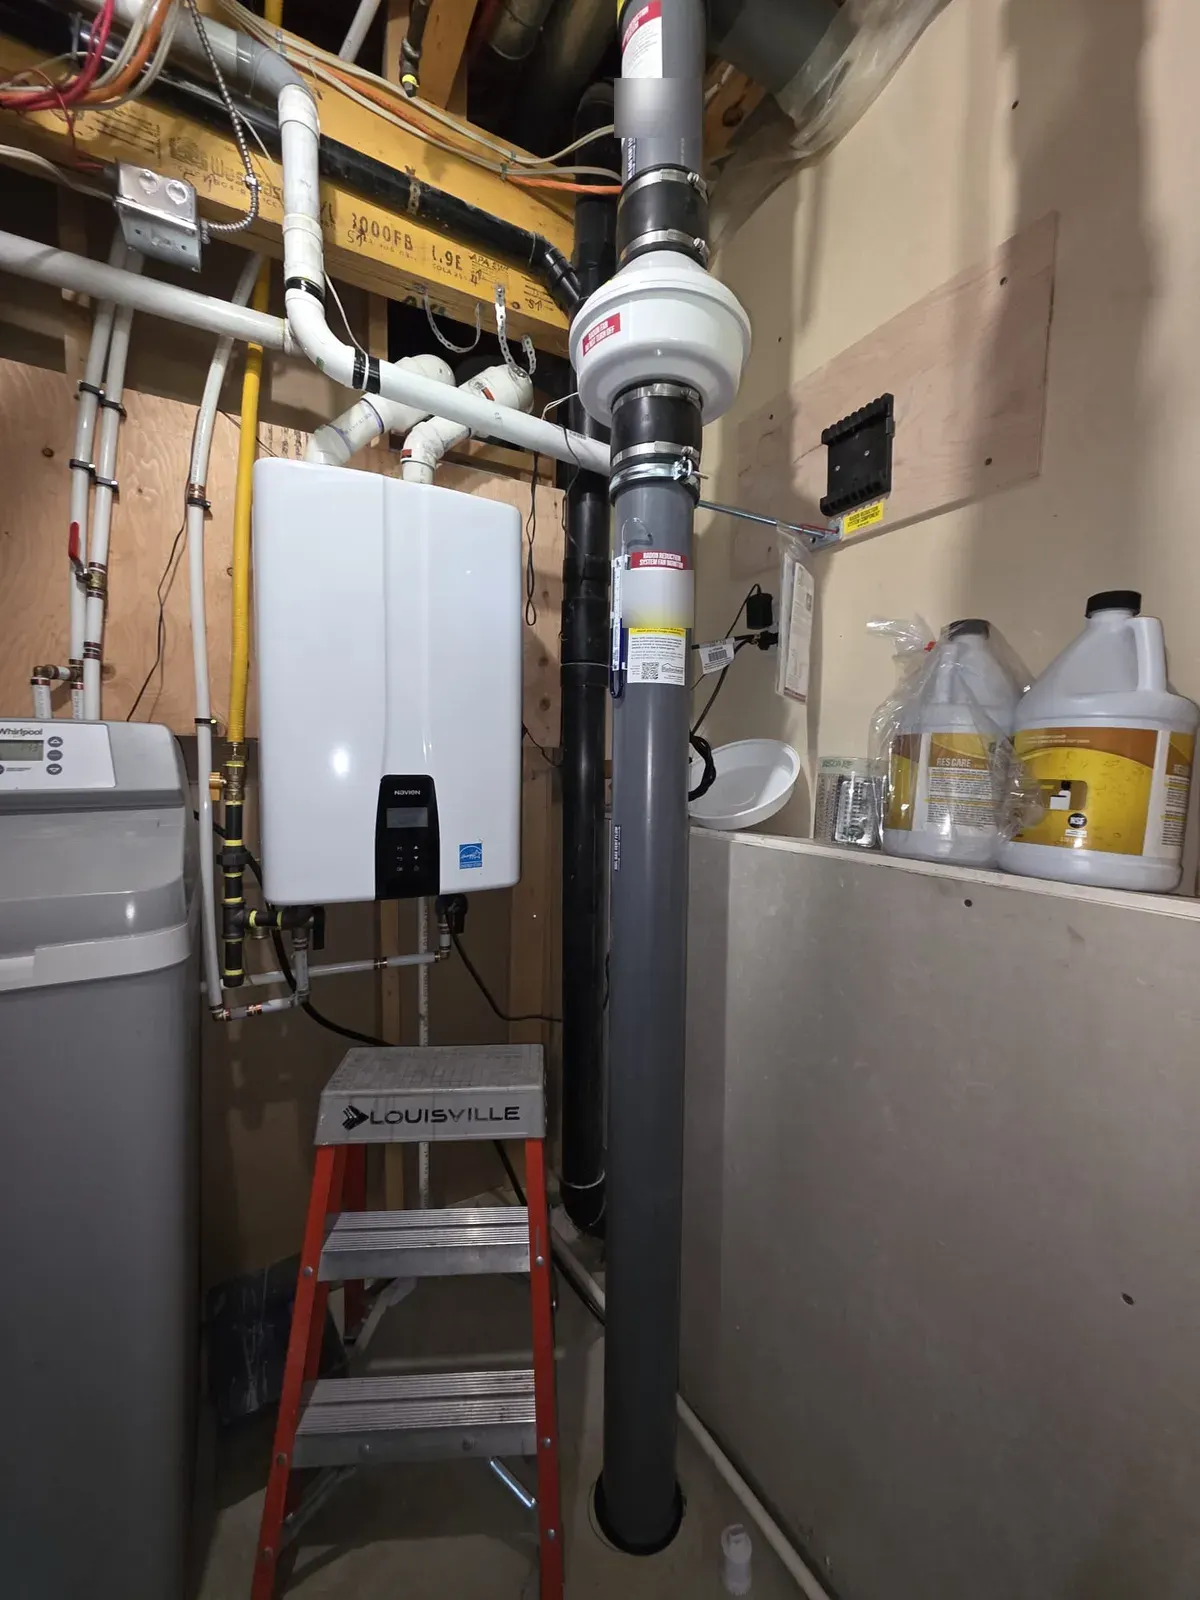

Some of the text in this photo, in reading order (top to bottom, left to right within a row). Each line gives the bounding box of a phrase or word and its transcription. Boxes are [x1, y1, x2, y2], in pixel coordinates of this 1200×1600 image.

[351, 212, 413, 251] 3000FB
[0, 728, 43, 736] Whirlpool
[369, 1106, 520, 1126] LOUISVILLE
